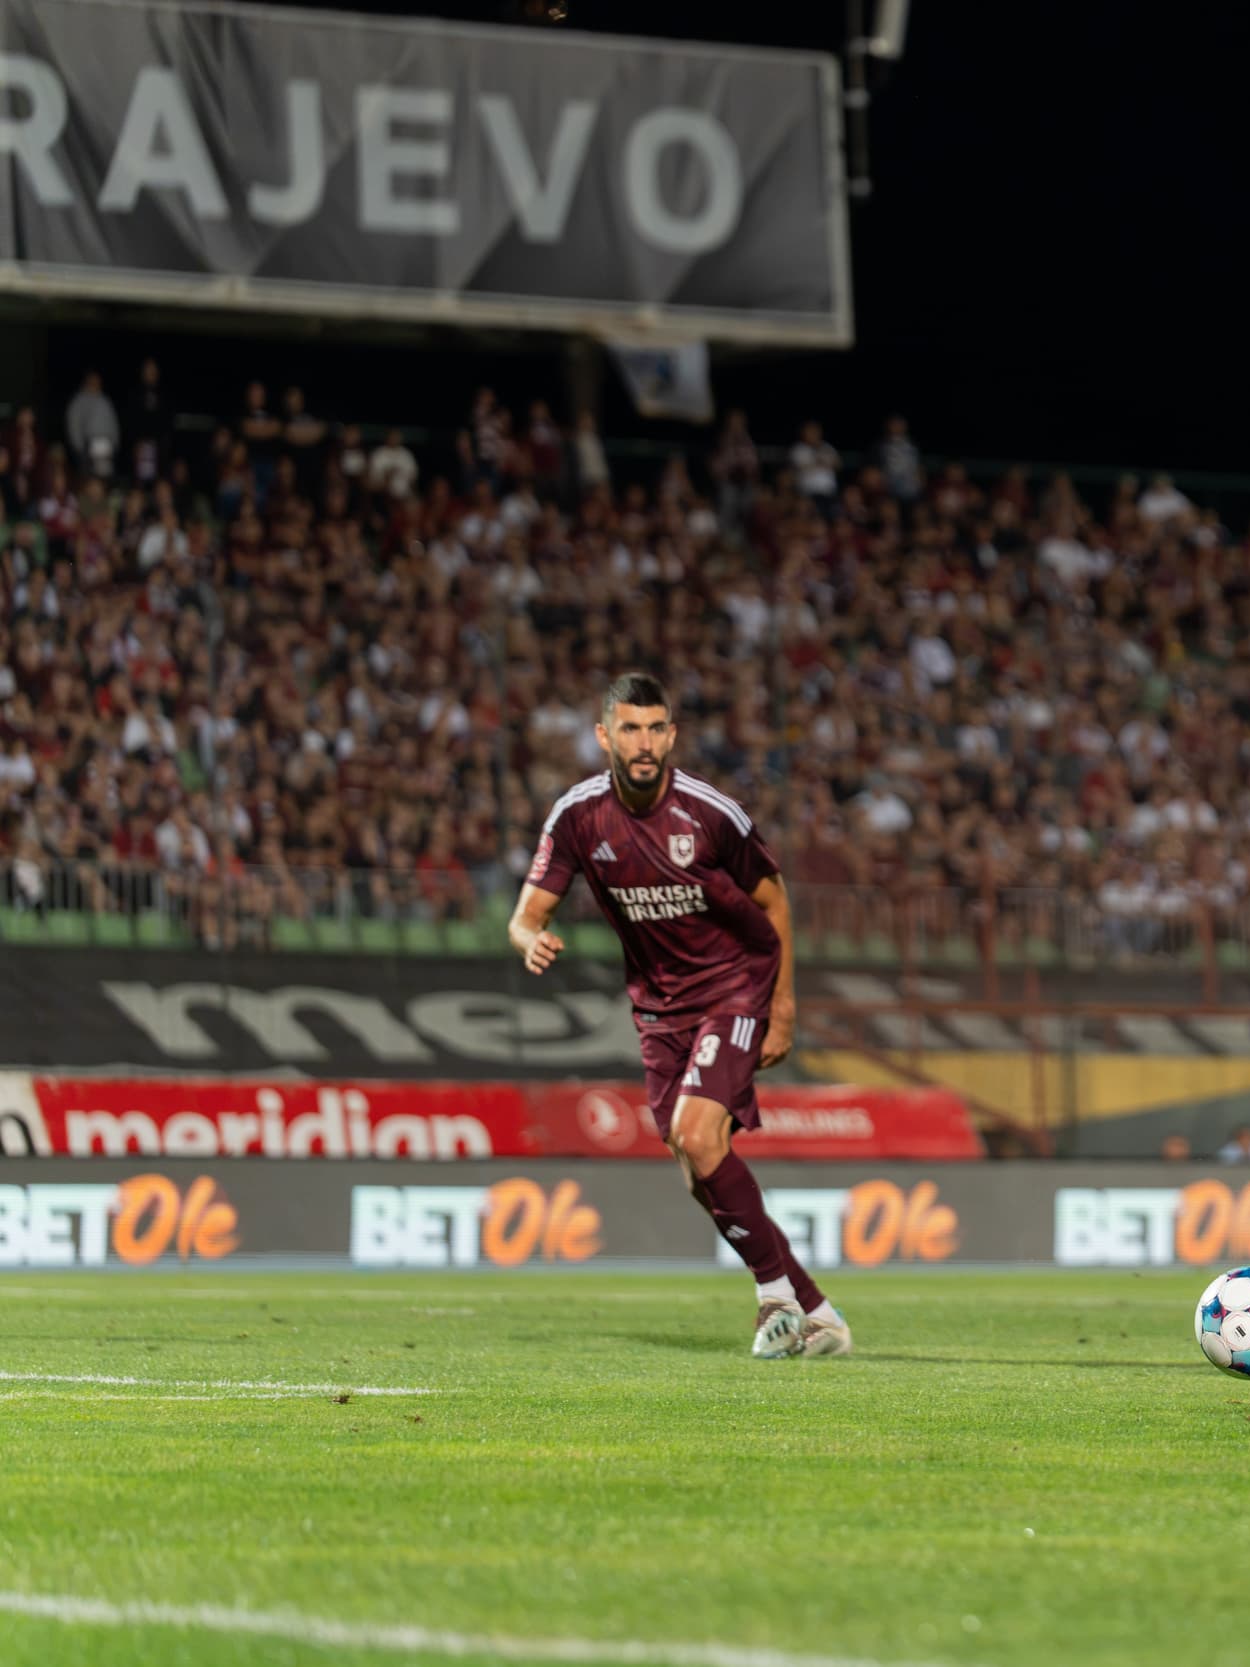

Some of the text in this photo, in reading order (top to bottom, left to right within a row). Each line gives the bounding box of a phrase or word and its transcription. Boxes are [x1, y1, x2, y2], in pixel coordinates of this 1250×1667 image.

[0, 54, 742, 253] RAJEVO
[608, 884, 704, 904] TURKISH
[622, 900, 709, 922] IRLINES
[695, 1034, 721, 1067] 3
